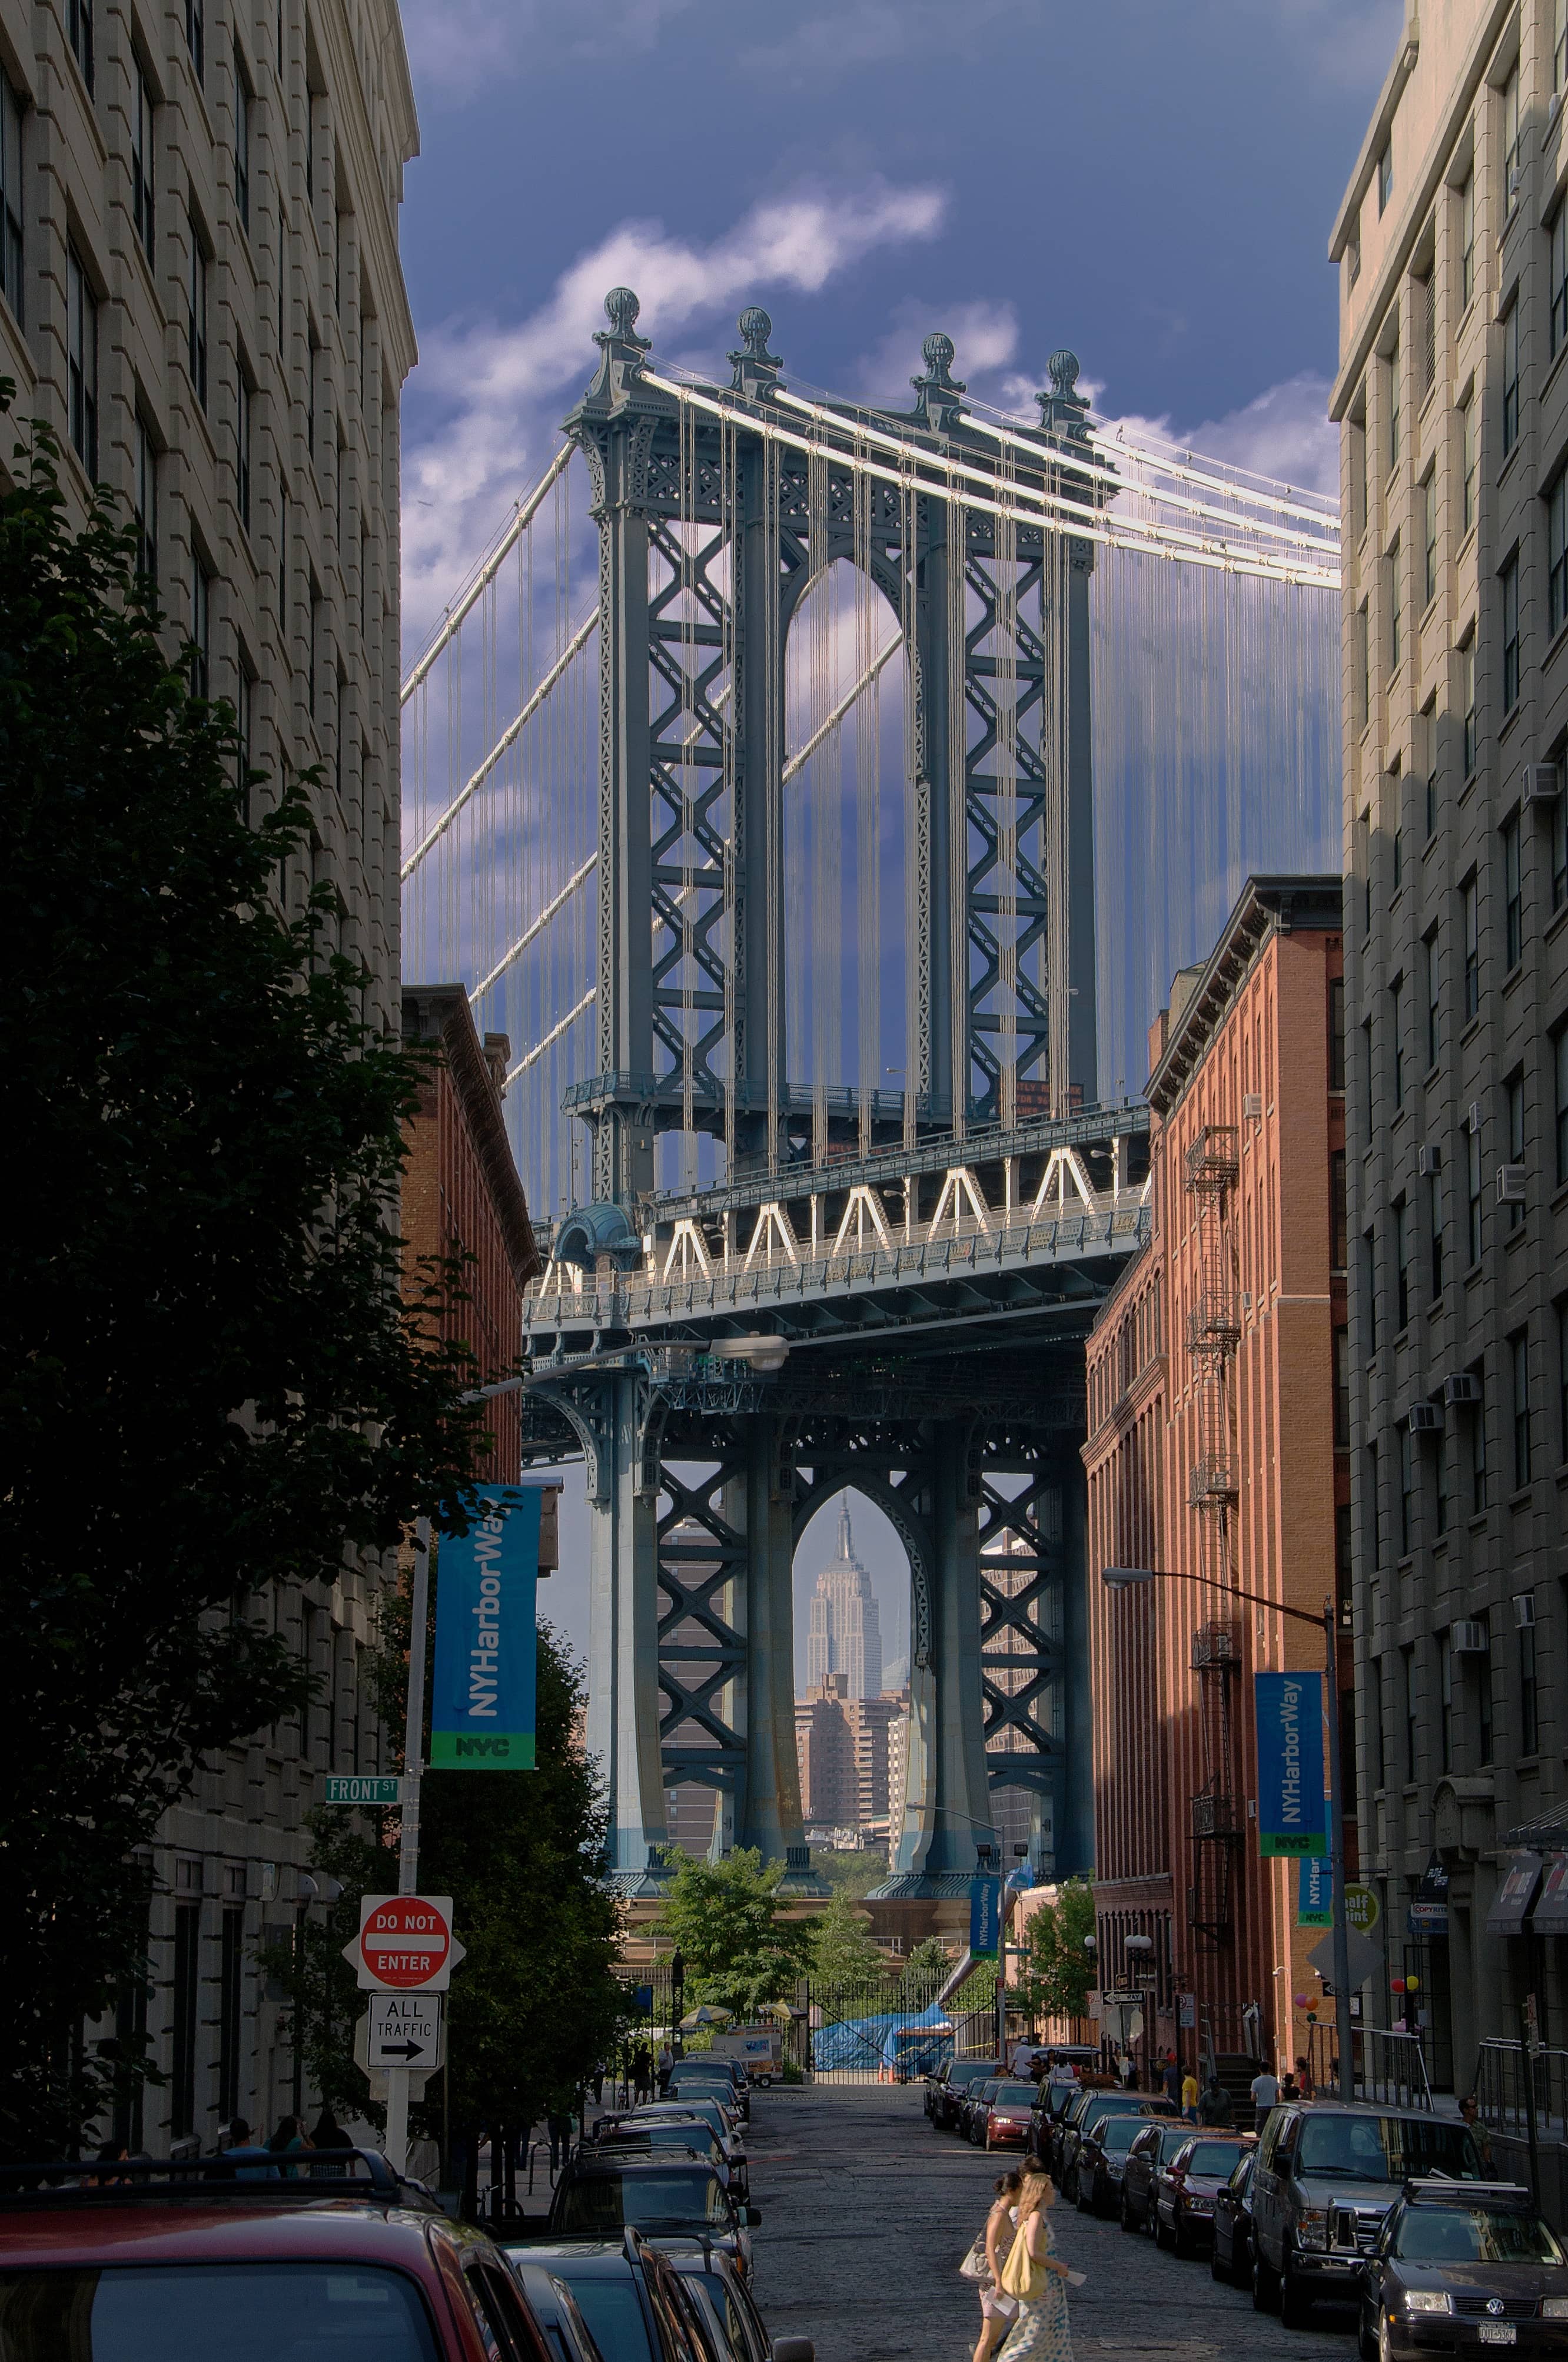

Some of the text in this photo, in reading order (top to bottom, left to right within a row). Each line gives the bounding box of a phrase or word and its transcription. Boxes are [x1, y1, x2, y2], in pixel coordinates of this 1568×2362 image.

[456, 1737, 510, 1757] NYC
[1280, 1680, 1303, 1823] NYHarborWay
[330, 1779, 396, 1800] FRONT ST
[1274, 1836, 1310, 1849] NYC
[979, 1882, 991, 1946] NYHarborWay
[1305, 1913, 1324, 1922] NYC
[376, 1915, 436, 1930] DO NOT
[377, 1955, 430, 1970] ENTER
[387, 2001, 423, 2018] ALL
[377, 2022, 431, 2037] TRAFFIC
